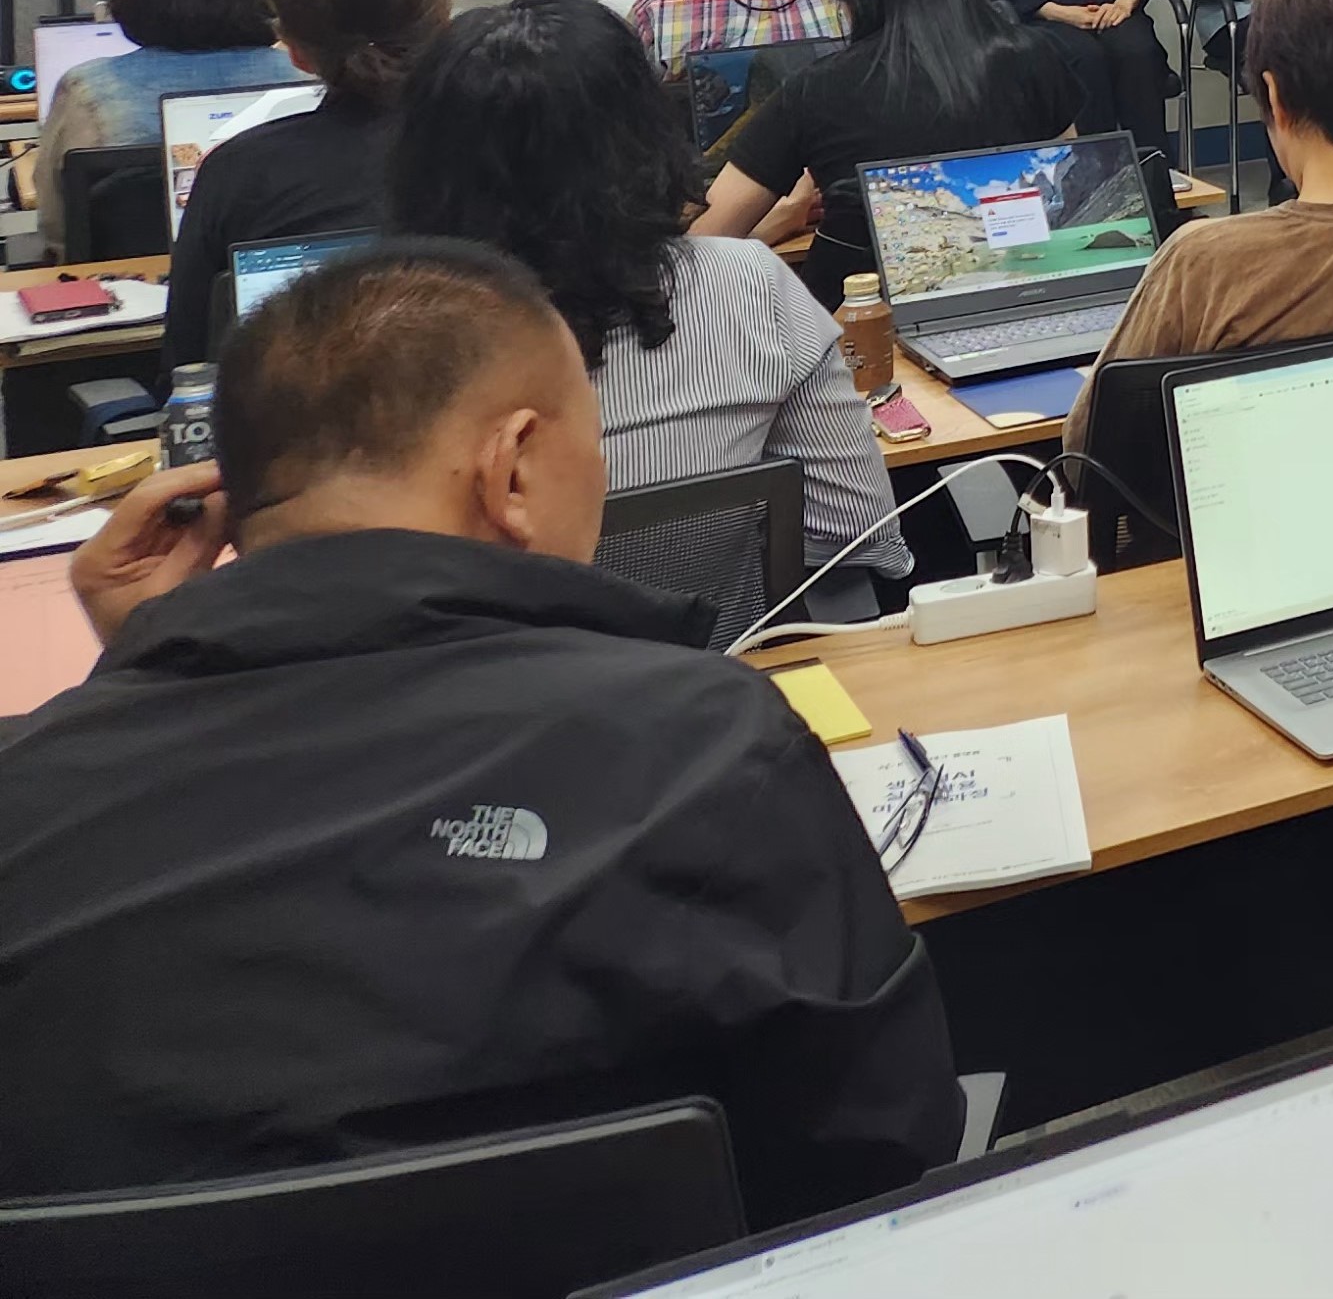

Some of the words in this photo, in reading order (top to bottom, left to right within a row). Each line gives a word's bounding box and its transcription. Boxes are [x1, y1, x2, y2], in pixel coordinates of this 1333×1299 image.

[472, 805, 516, 824] THE
[430, 817, 512, 842] NORTH
[447, 838, 504, 858] FACE
